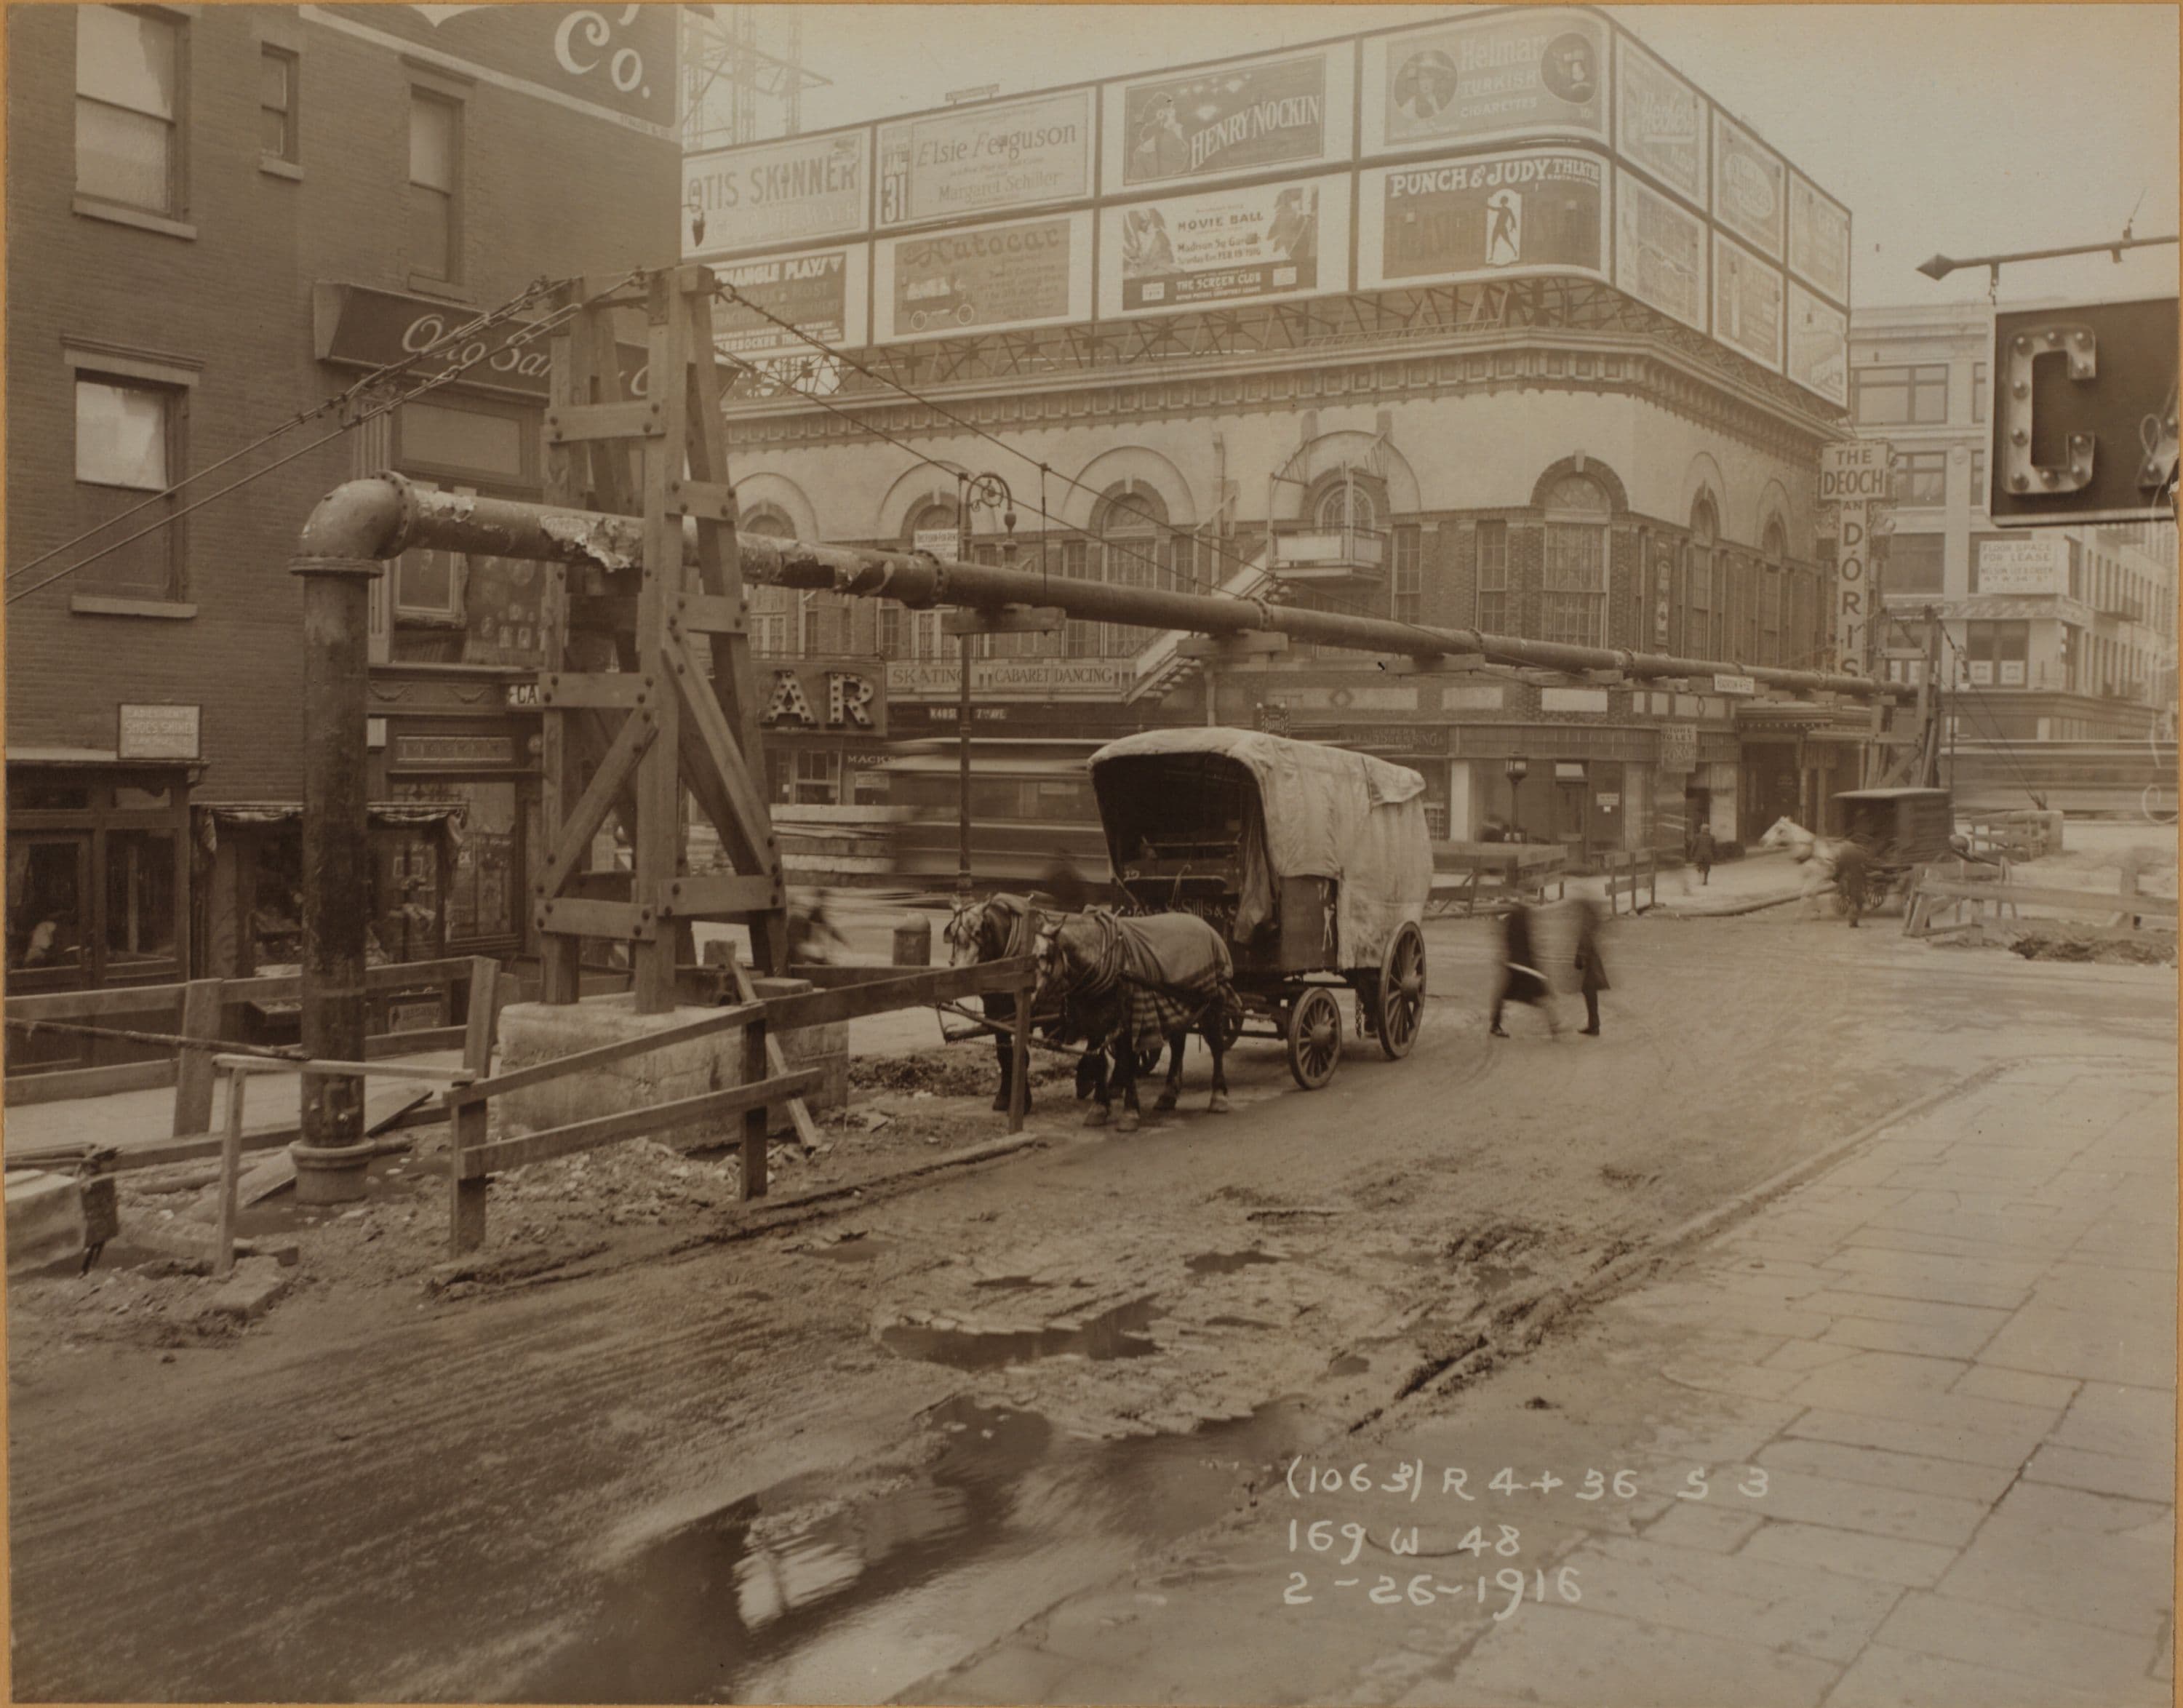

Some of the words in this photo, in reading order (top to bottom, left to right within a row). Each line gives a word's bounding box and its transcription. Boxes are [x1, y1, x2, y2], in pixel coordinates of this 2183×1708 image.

[554, 9, 650, 99] Co.
[1460, 34, 1549, 71] Helmar
[1461, 70, 1537, 96] TURKISH
[1460, 97, 1537, 117] CIGARETTES
[1190, 108, 1252, 173] HENRY
[1251, 95, 1321, 139] NOCKIN
[917, 140, 968, 168] Elsie
[972, 124, 1077, 161] Ferguson
[688, 172, 739, 213] OTIS
[750, 156, 857, 205] SKINNER
[939, 181, 1000, 203] Margaret
[1005, 171, 1059, 192] Schiller
[1390, 168, 1468, 198] PUNCH
[1469, 164, 1486, 189] &
[1487, 159, 1552, 187] JUDY
[884, 177, 906, 222] 31
[1178, 216, 1223, 232] MOVIE
[1230, 212, 1263, 225] BALL
[903, 228, 1060, 268] Autocar
[1178, 242, 1213, 252] Madison
[784, 257, 829, 280] PLAYS
[1176, 279, 1194, 292] THE
[1196, 274, 1234, 290] SCREEN
[1238, 272, 1261, 284] CLUB
[1835, 450, 1873, 465] THE
[1823, 469, 1883, 495] DEOCH
[1843, 501, 1863, 511] AN
[1984, 553, 2003, 562] FOR
[2011, 552, 2051, 562] LEASE
[995, 668, 1050, 683] CABARET
[1054, 667, 1113, 682] DANCING
[124, 719, 158, 735] SHOES
[847, 754, 897, 765] MACK'S
[1214, 905, 1224, 919] &
